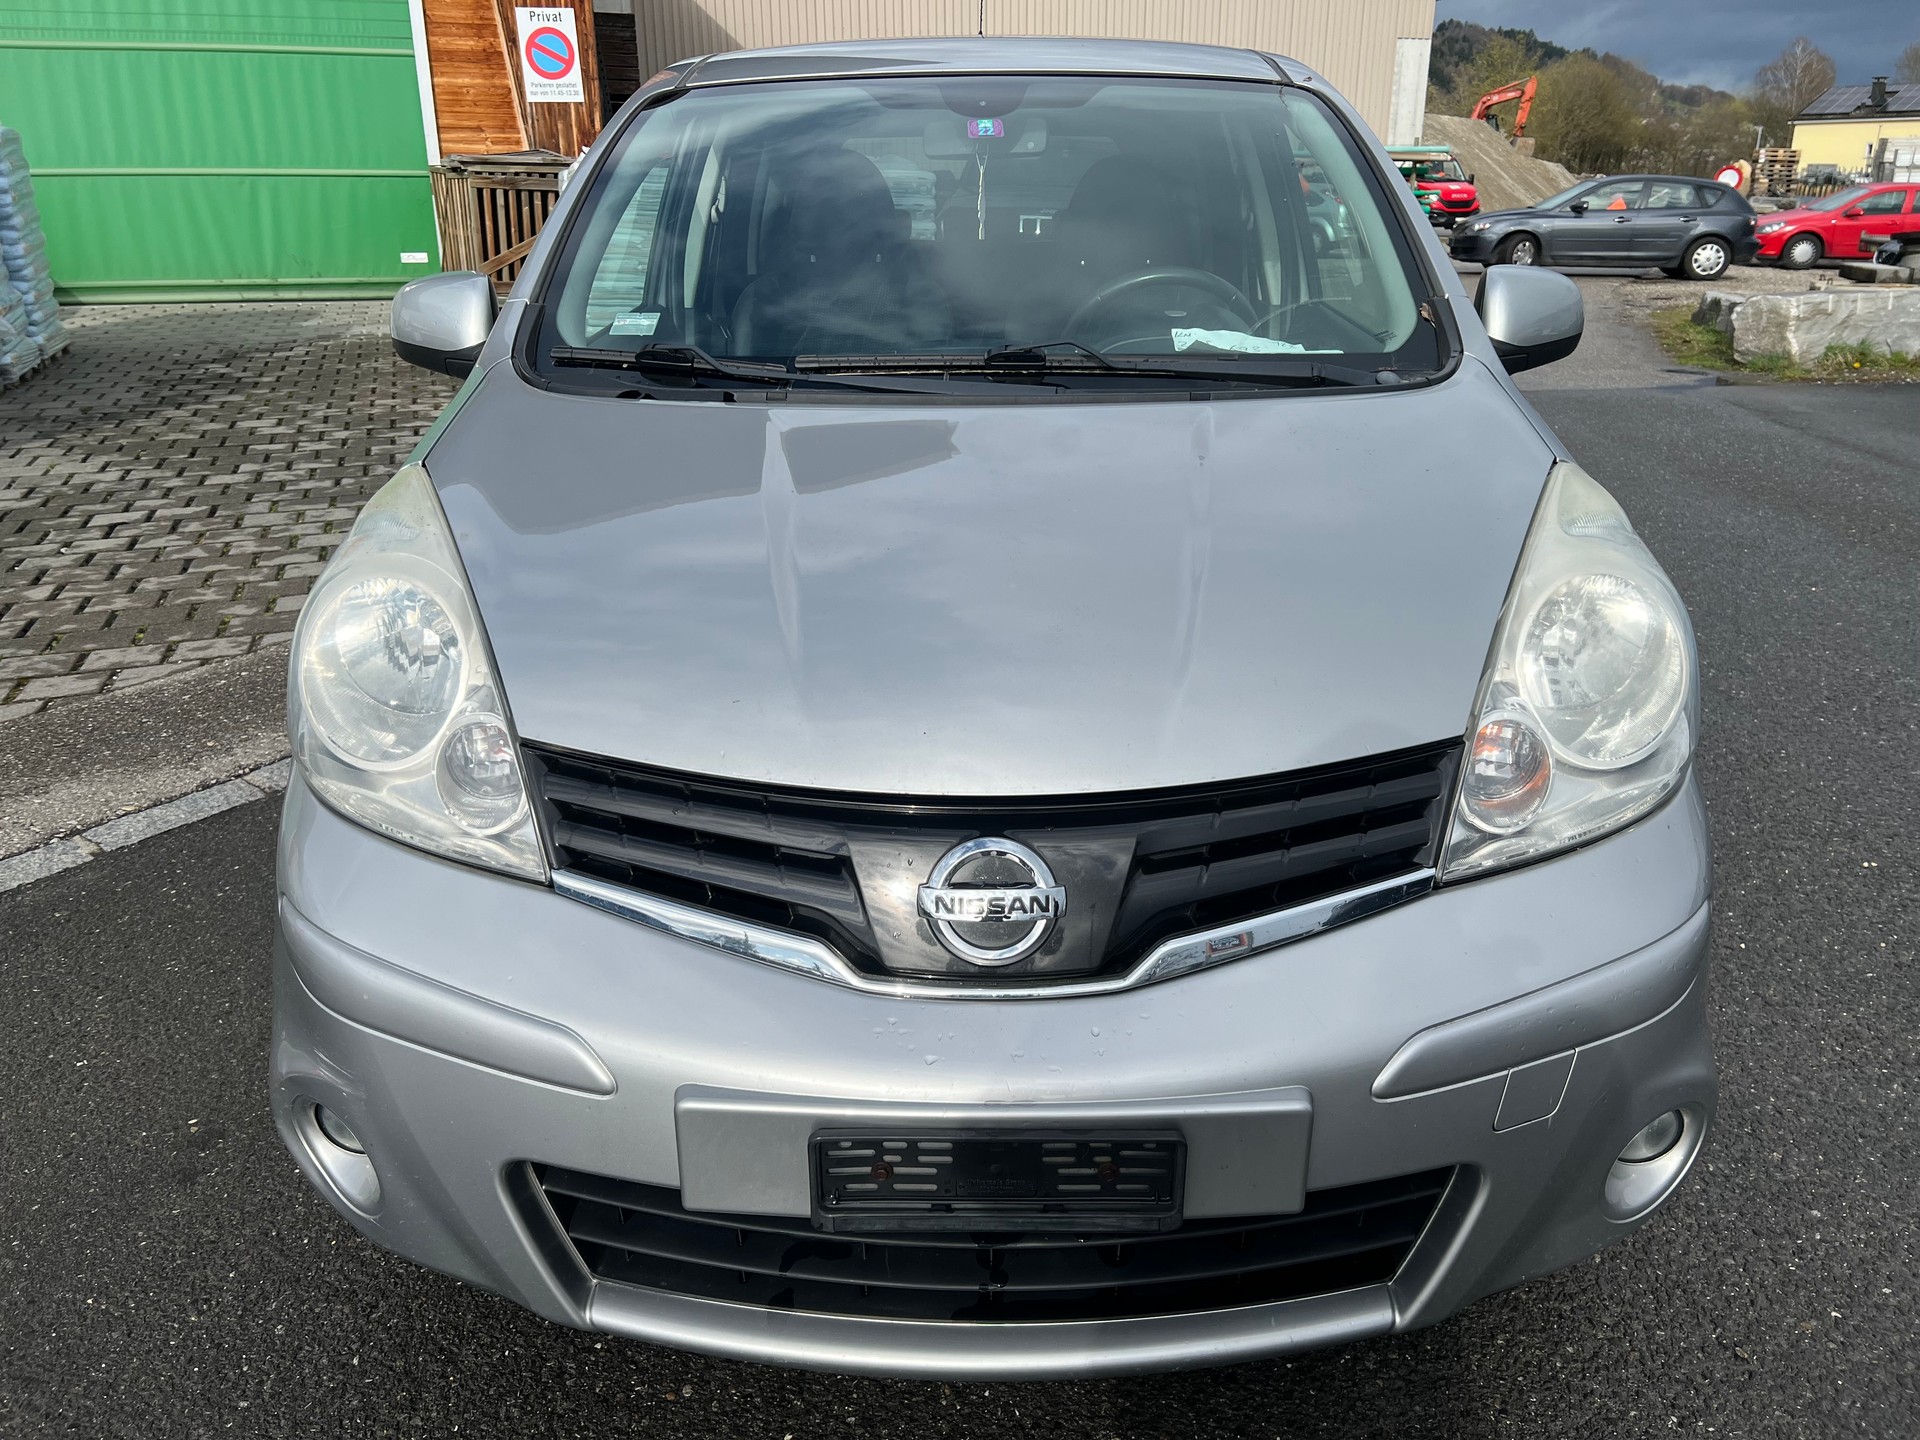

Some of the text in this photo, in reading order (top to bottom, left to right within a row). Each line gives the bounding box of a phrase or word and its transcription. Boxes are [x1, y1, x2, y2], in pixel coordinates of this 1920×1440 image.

[529, 10, 562, 22] Privat
[978, 127, 995, 136] 22
[934, 894, 1050, 916] NISSAN
